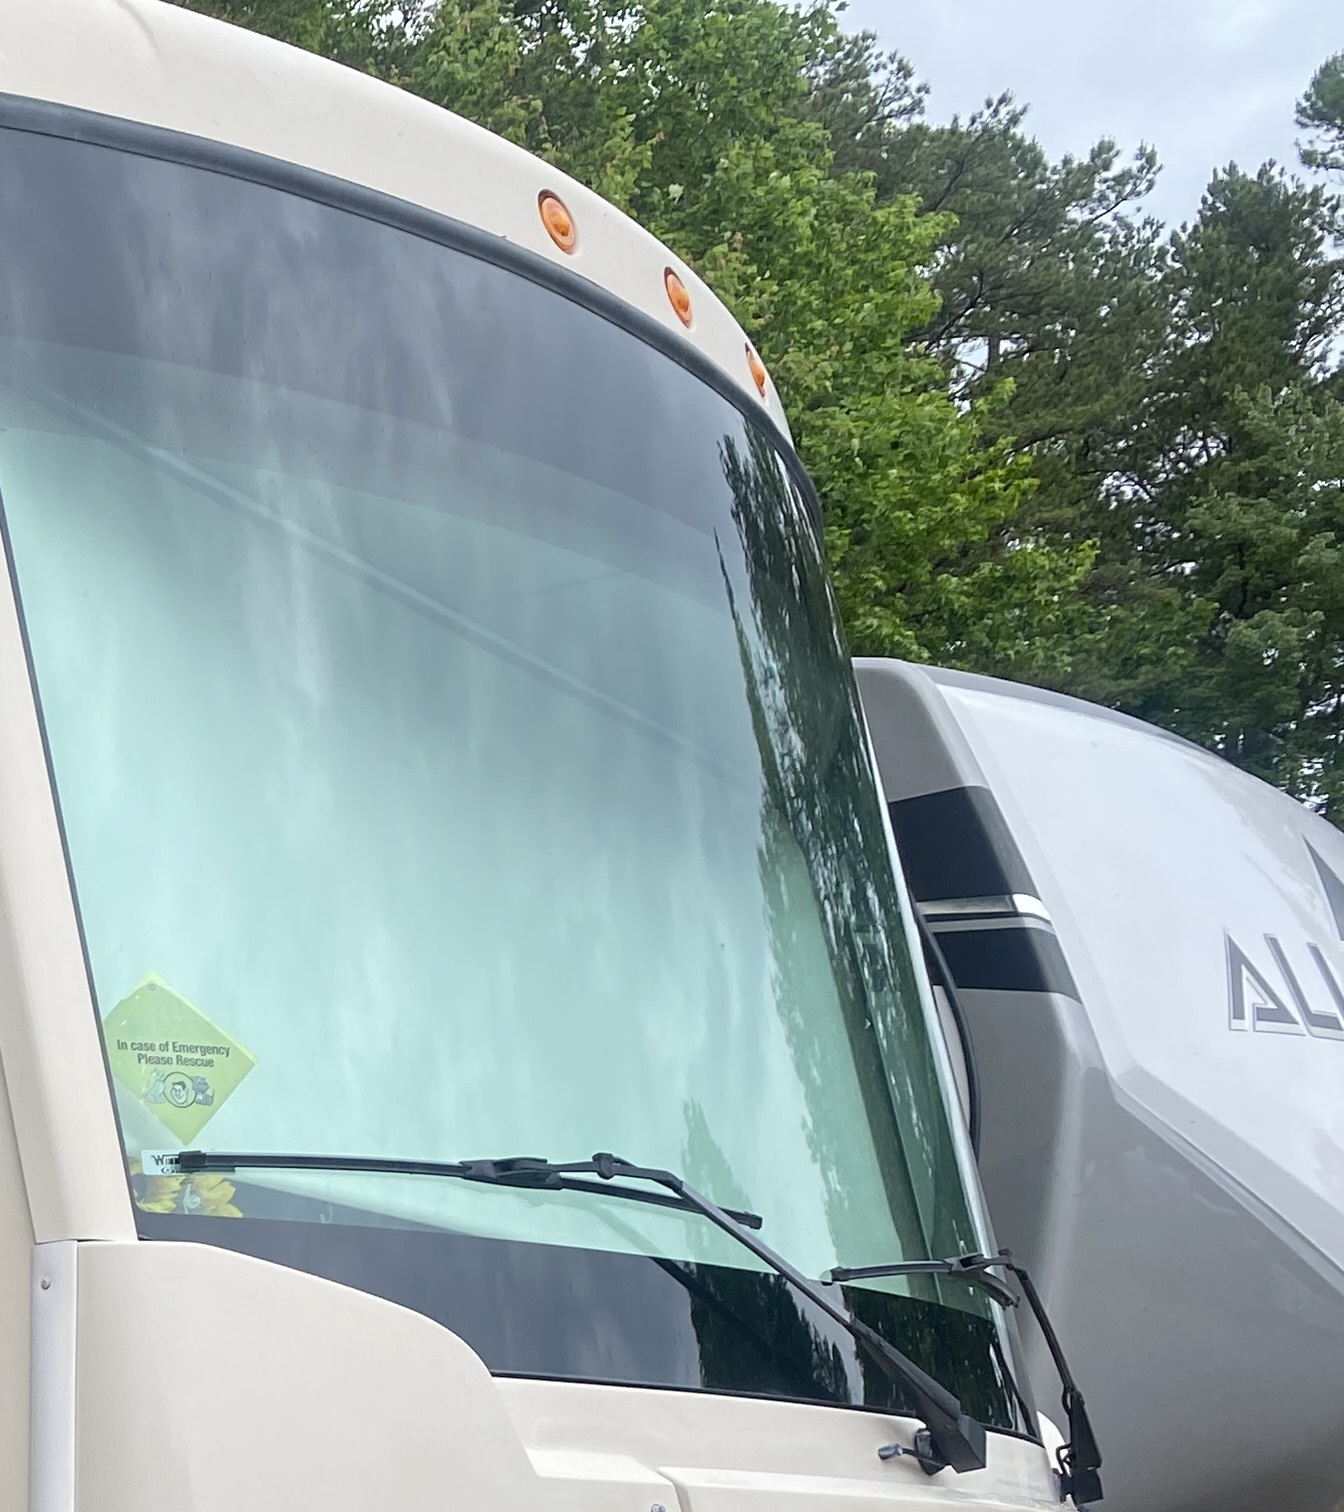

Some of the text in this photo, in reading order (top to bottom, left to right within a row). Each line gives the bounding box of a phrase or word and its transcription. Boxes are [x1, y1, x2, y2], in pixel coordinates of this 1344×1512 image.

[117, 1039, 230, 1058] In case of Emergency
[137, 1053, 215, 1067] Please Rescue
